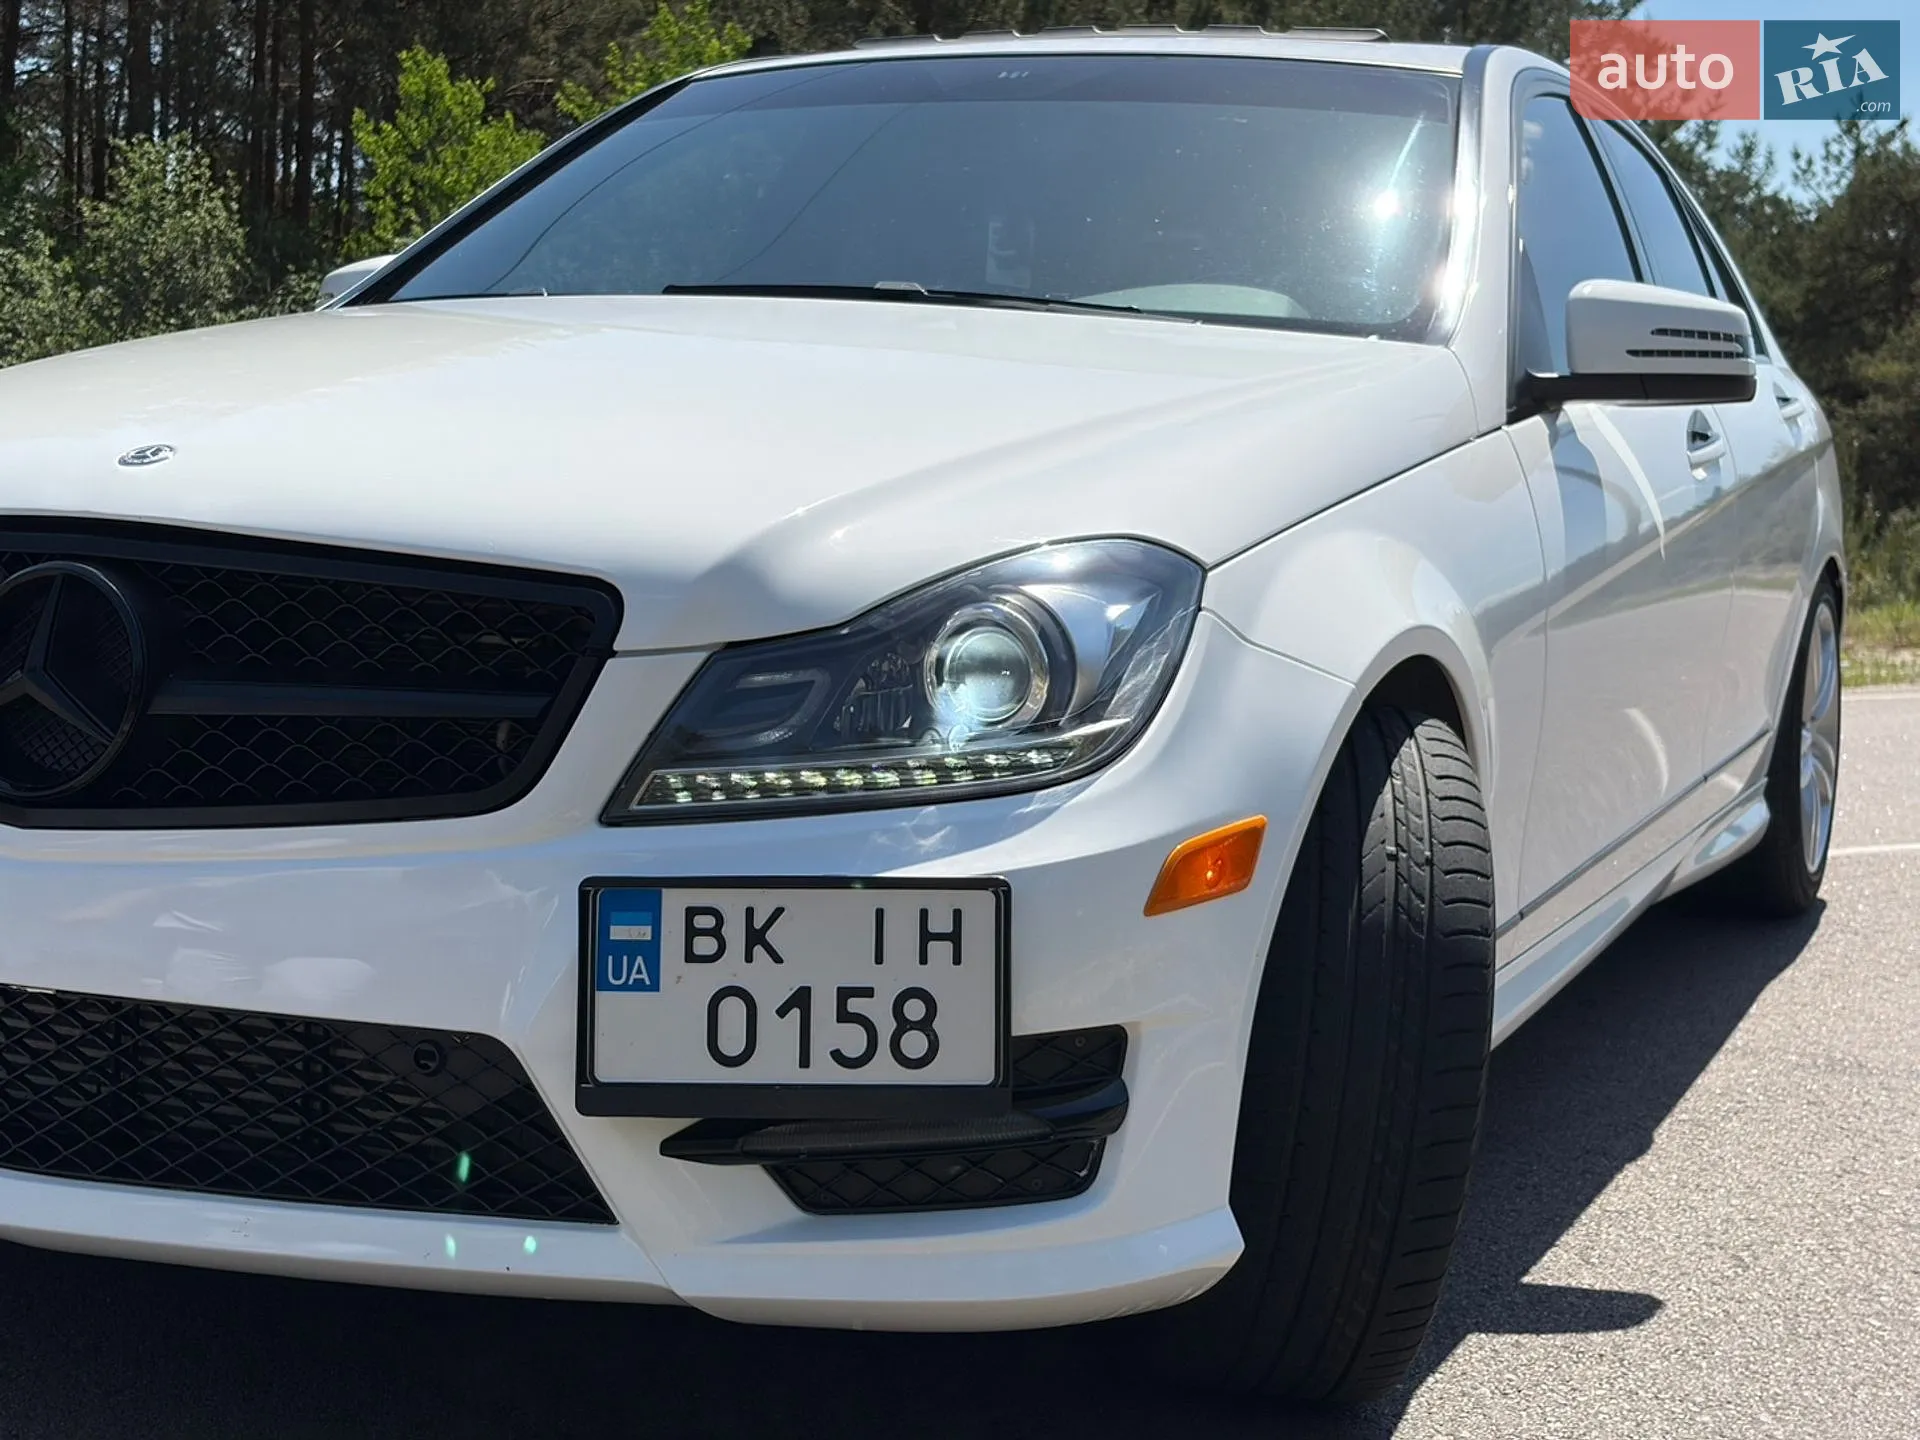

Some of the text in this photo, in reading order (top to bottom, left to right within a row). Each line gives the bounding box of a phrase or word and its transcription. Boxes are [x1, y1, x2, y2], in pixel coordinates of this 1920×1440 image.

[684, 906, 963, 966] BK IH
[607, 954, 651, 986] UA
[706, 985, 940, 1070] 0158
